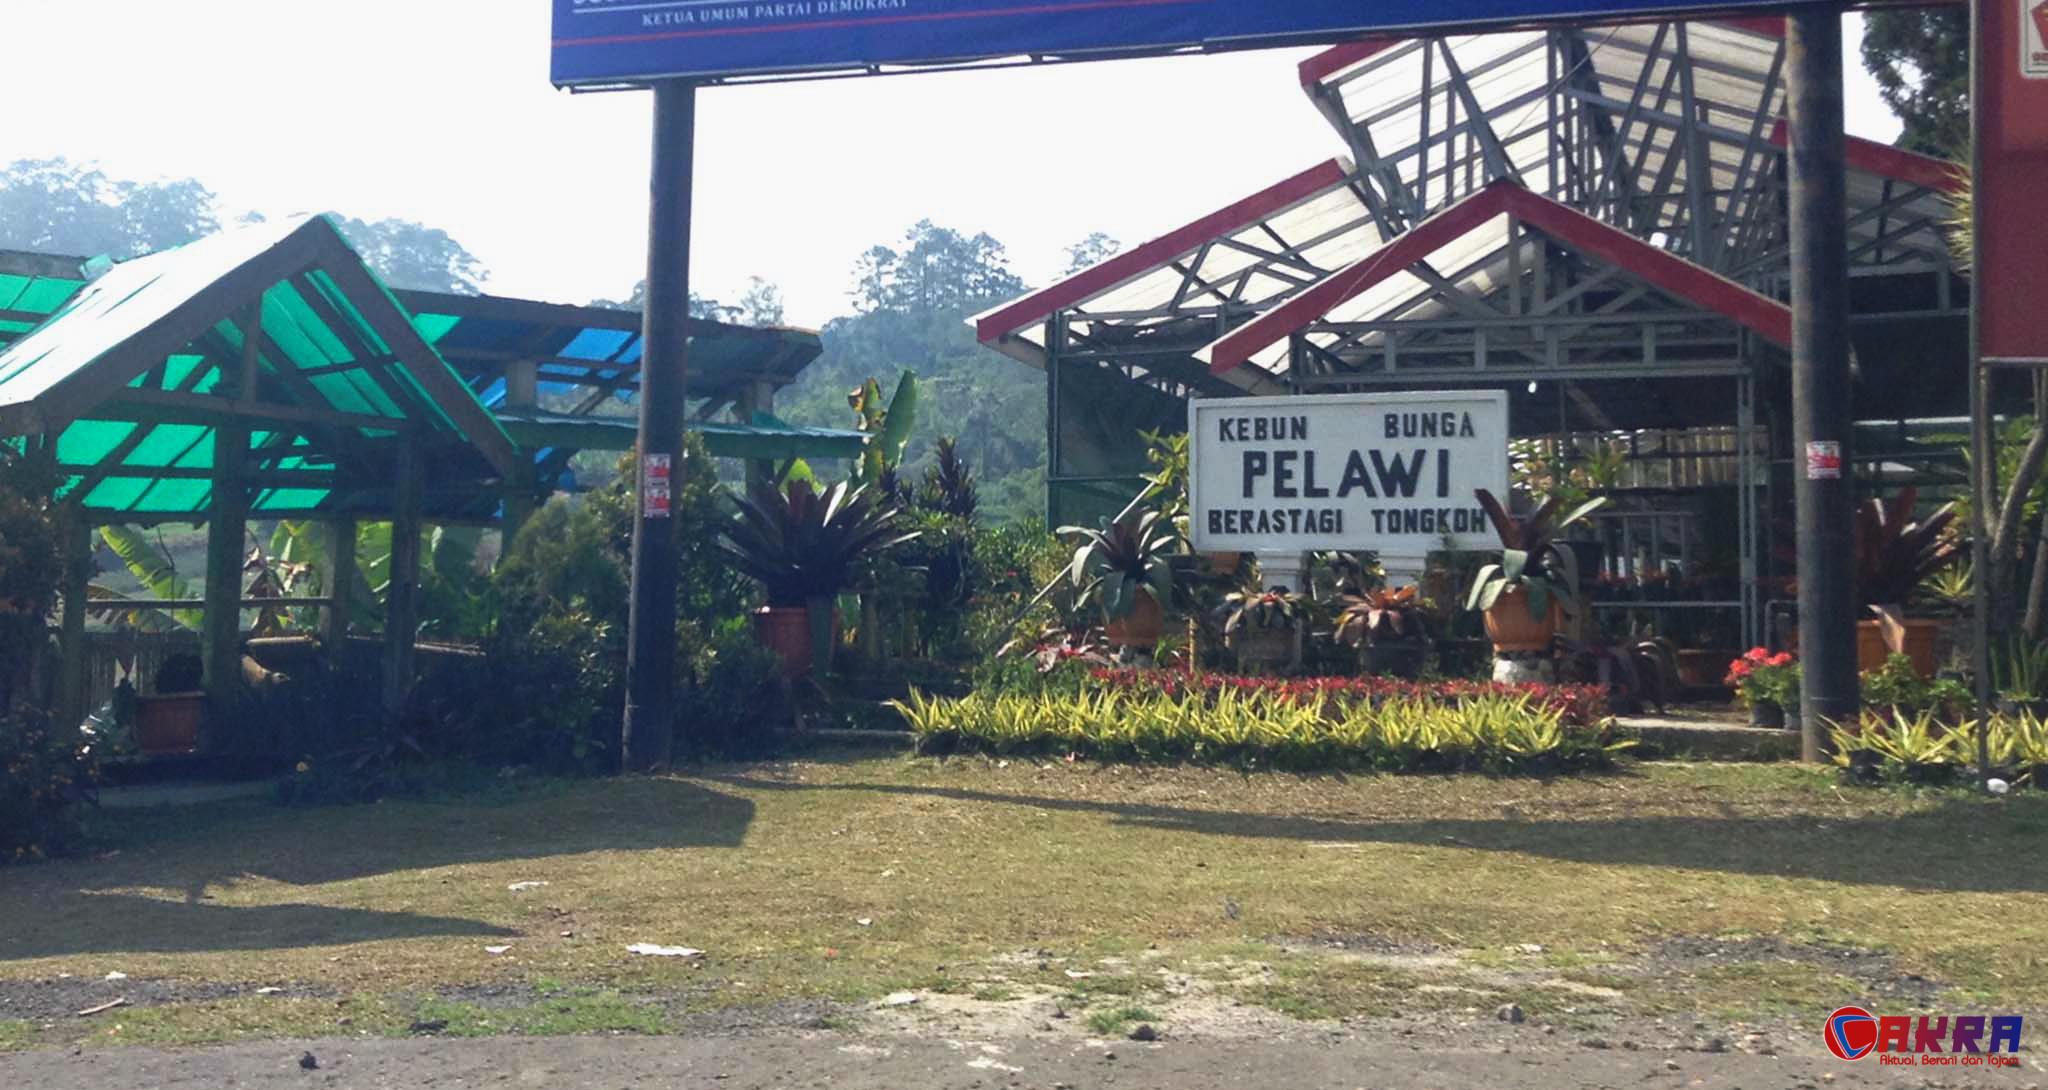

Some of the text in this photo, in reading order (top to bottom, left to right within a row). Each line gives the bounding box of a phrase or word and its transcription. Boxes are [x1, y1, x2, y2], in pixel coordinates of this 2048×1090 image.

[642, 11, 695, 26] KETUA
[700, 7, 749, 22] UMUM
[755, 2, 812, 18] PARTAI
[1219, 412, 1475, 441] KEBUN BUNGA
[1242, 449, 1450, 498] PELAWI
[1208, 508, 1486, 535] BERASTAGI TONGKOH
